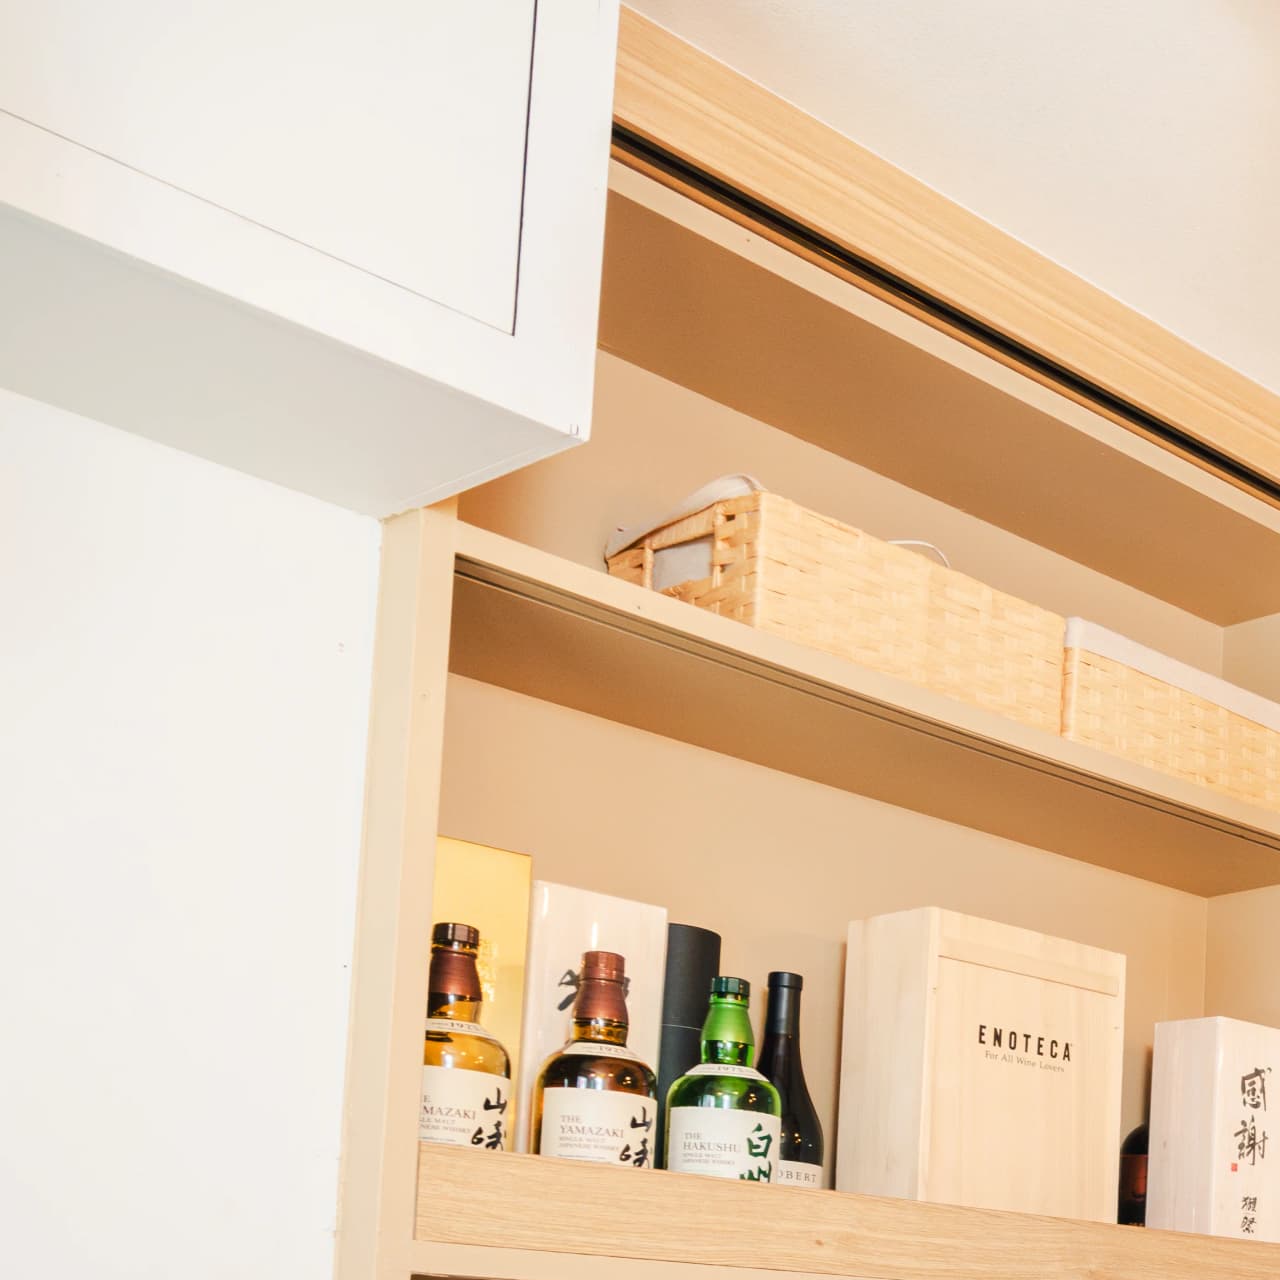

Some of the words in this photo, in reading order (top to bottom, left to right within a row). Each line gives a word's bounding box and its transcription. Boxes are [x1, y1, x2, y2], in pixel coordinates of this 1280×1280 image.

[978, 1024, 1071, 1062] ENOTECA
[985, 1050, 998, 1060] For
[1001, 1053, 1014, 1063] All
[1016, 1056, 1036, 1067] Wine
[1039, 1061, 1065, 1073] Lovers
[422, 1105, 476, 1121] MAZAKI
[1234, 1067, 1272, 1166] 感謝
[560, 1124, 624, 1139] YAMAZAKI
